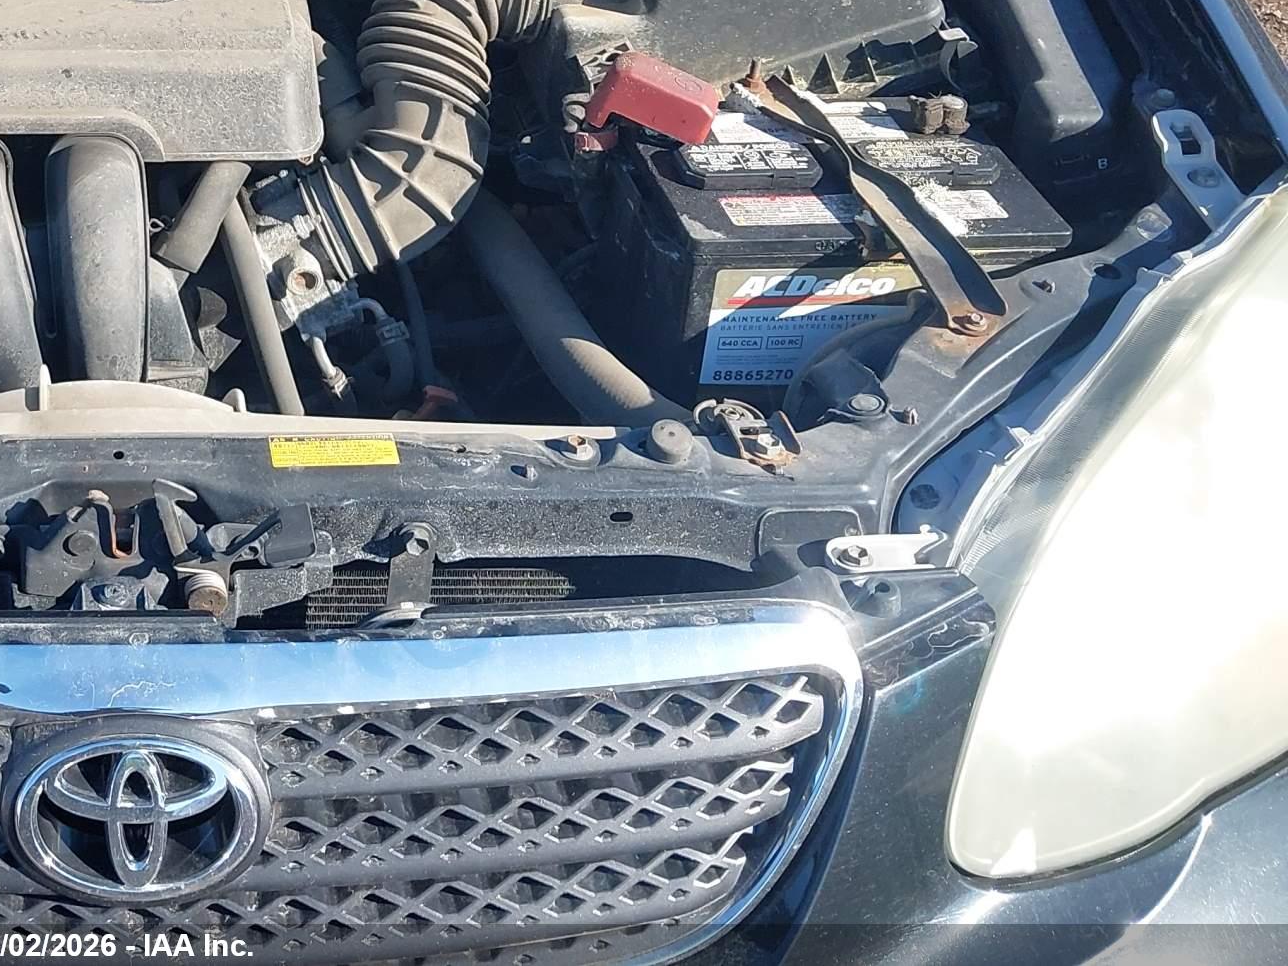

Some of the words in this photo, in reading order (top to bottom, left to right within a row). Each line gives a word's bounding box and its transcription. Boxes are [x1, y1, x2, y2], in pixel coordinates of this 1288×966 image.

[732, 273, 897, 297] ACDelco
[830, 313, 878, 322] BATTERY
[721, 339, 739, 347] 640
[740, 339, 759, 347] CCA
[770, 338, 786, 346] 100
[787, 338, 800, 346] RC
[712, 369, 794, 381] 88865270
